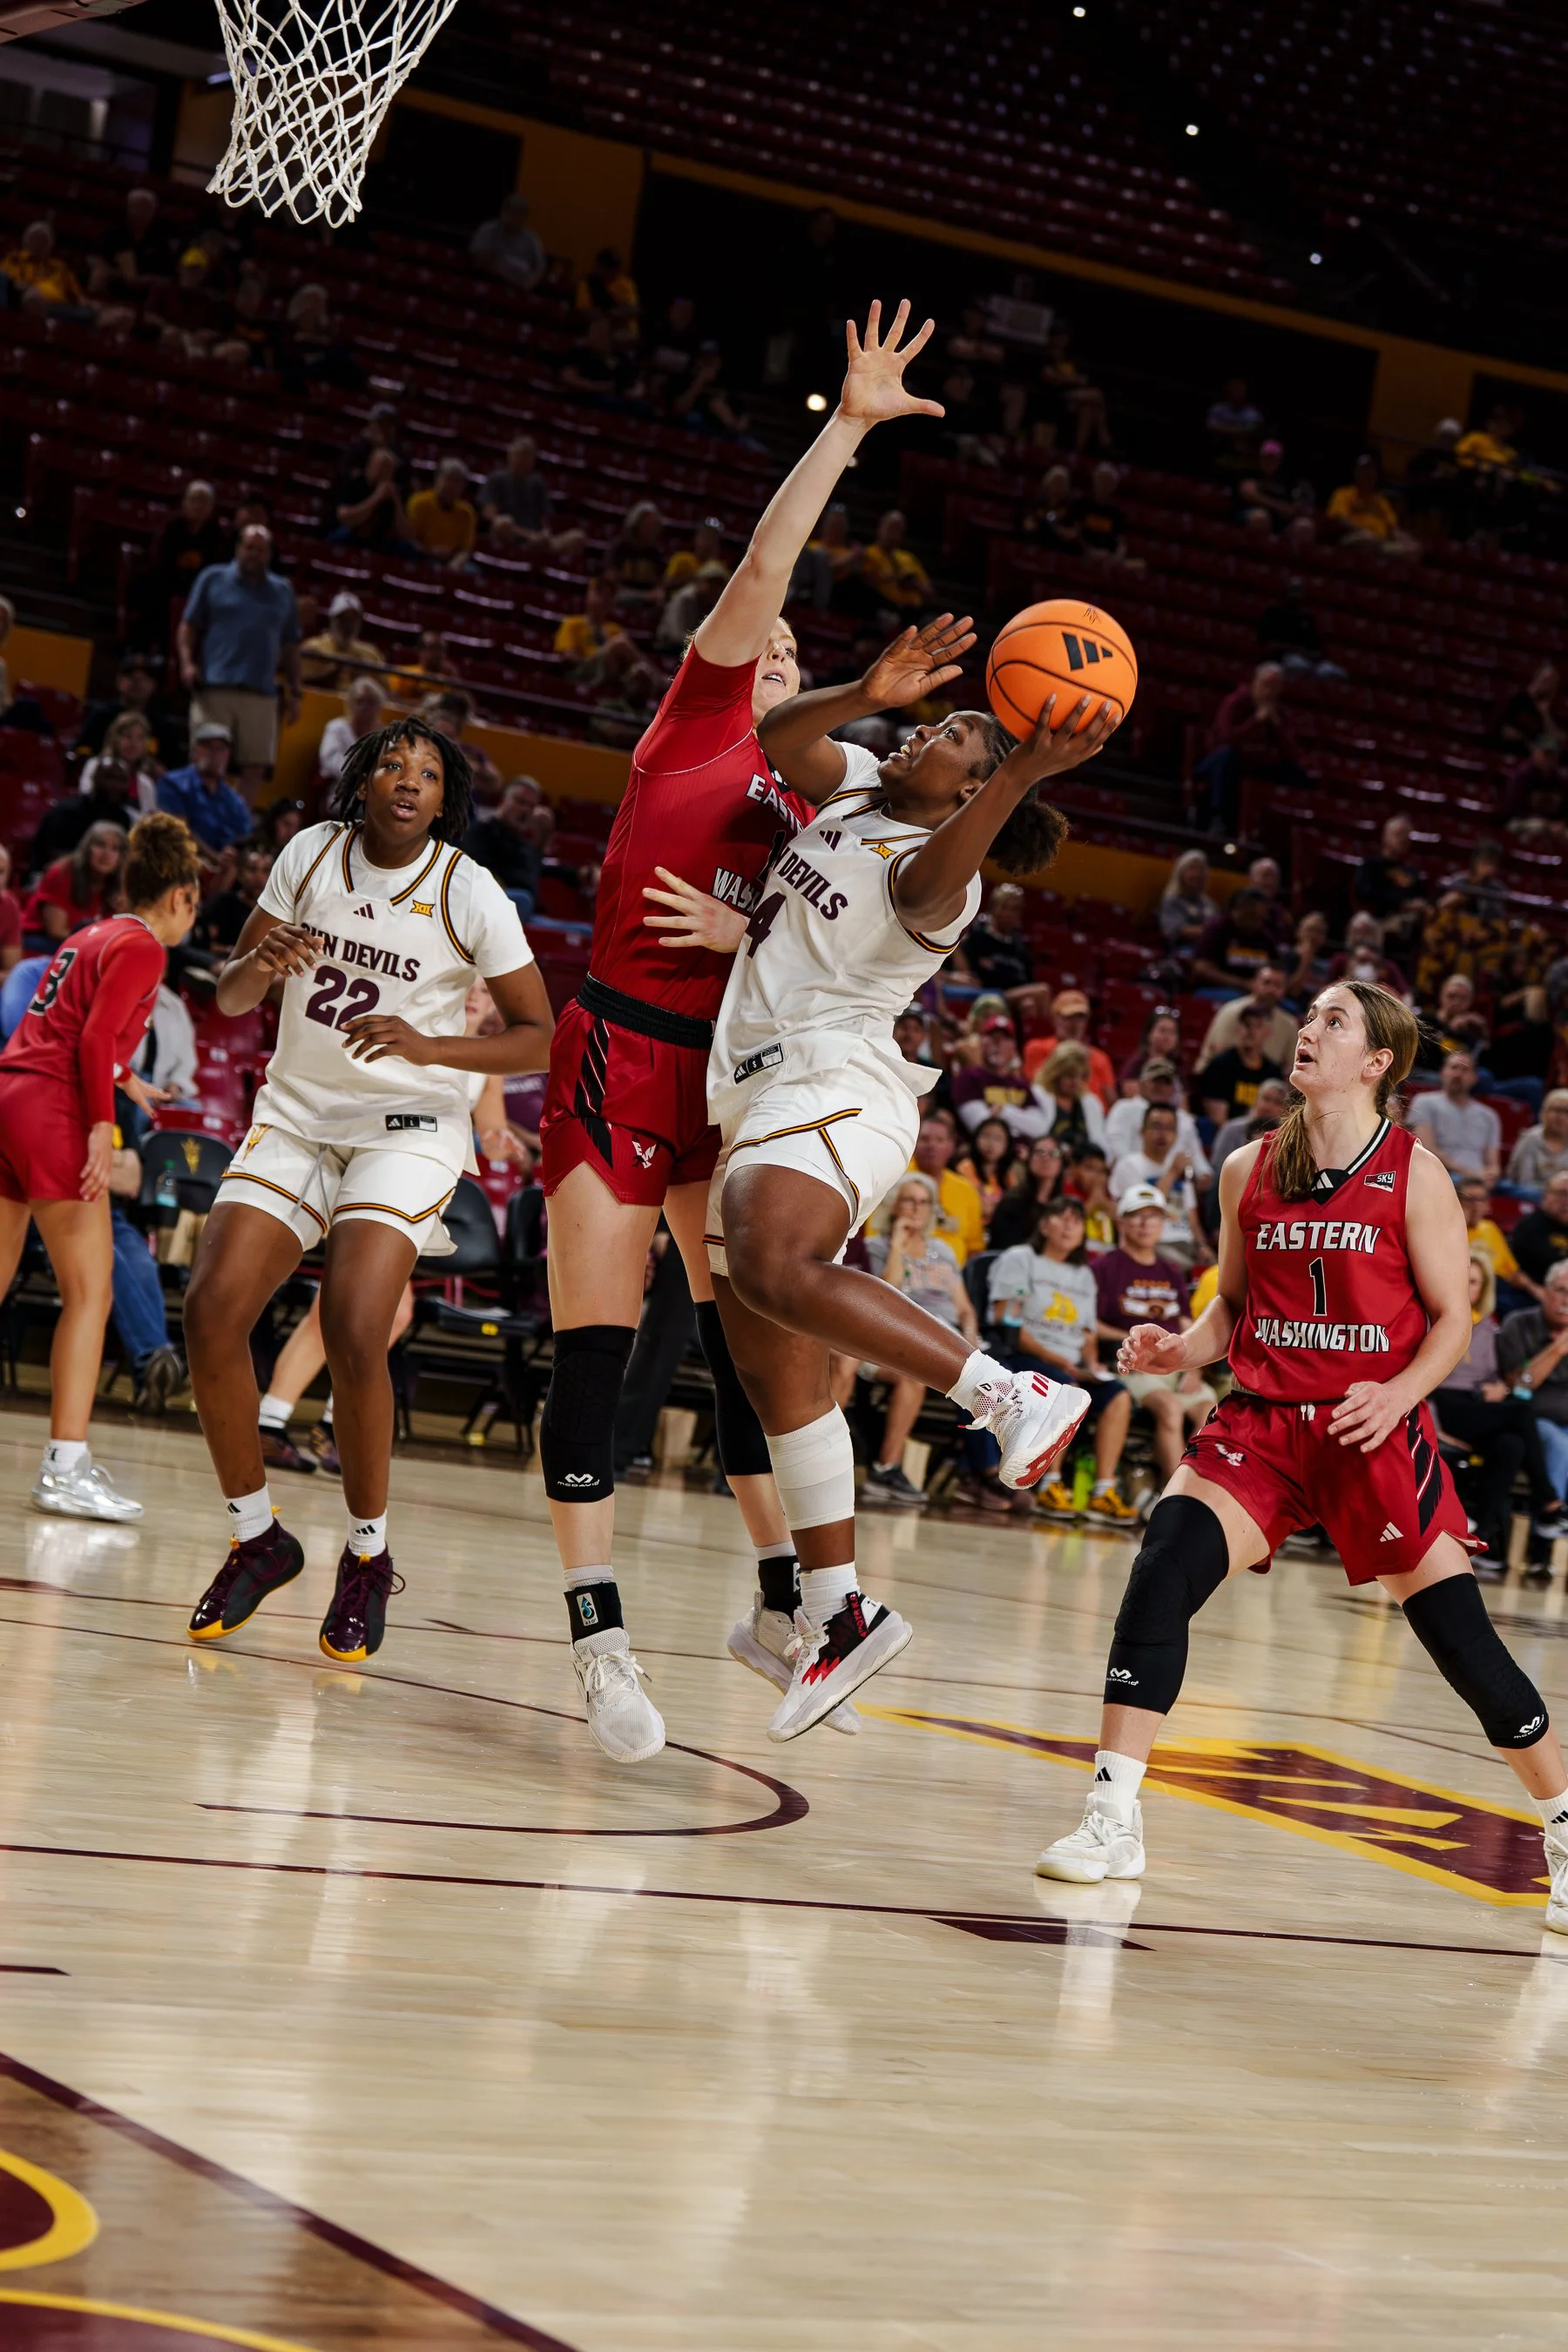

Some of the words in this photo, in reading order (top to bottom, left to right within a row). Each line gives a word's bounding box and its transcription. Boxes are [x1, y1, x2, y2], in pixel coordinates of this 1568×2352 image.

[778, 853, 848, 920] DEVILS
[745, 891, 787, 959] 4
[28, 948, 78, 1017] 3
[341, 939, 421, 983] DEVILS
[305, 964, 380, 1036] 22
[1376, 1173, 1394, 1184] SKY
[1254, 1221, 1382, 1254] EASTERN
[1308, 1256, 1328, 1316] 1
[1254, 1318, 1390, 1353] WASHINGTON
